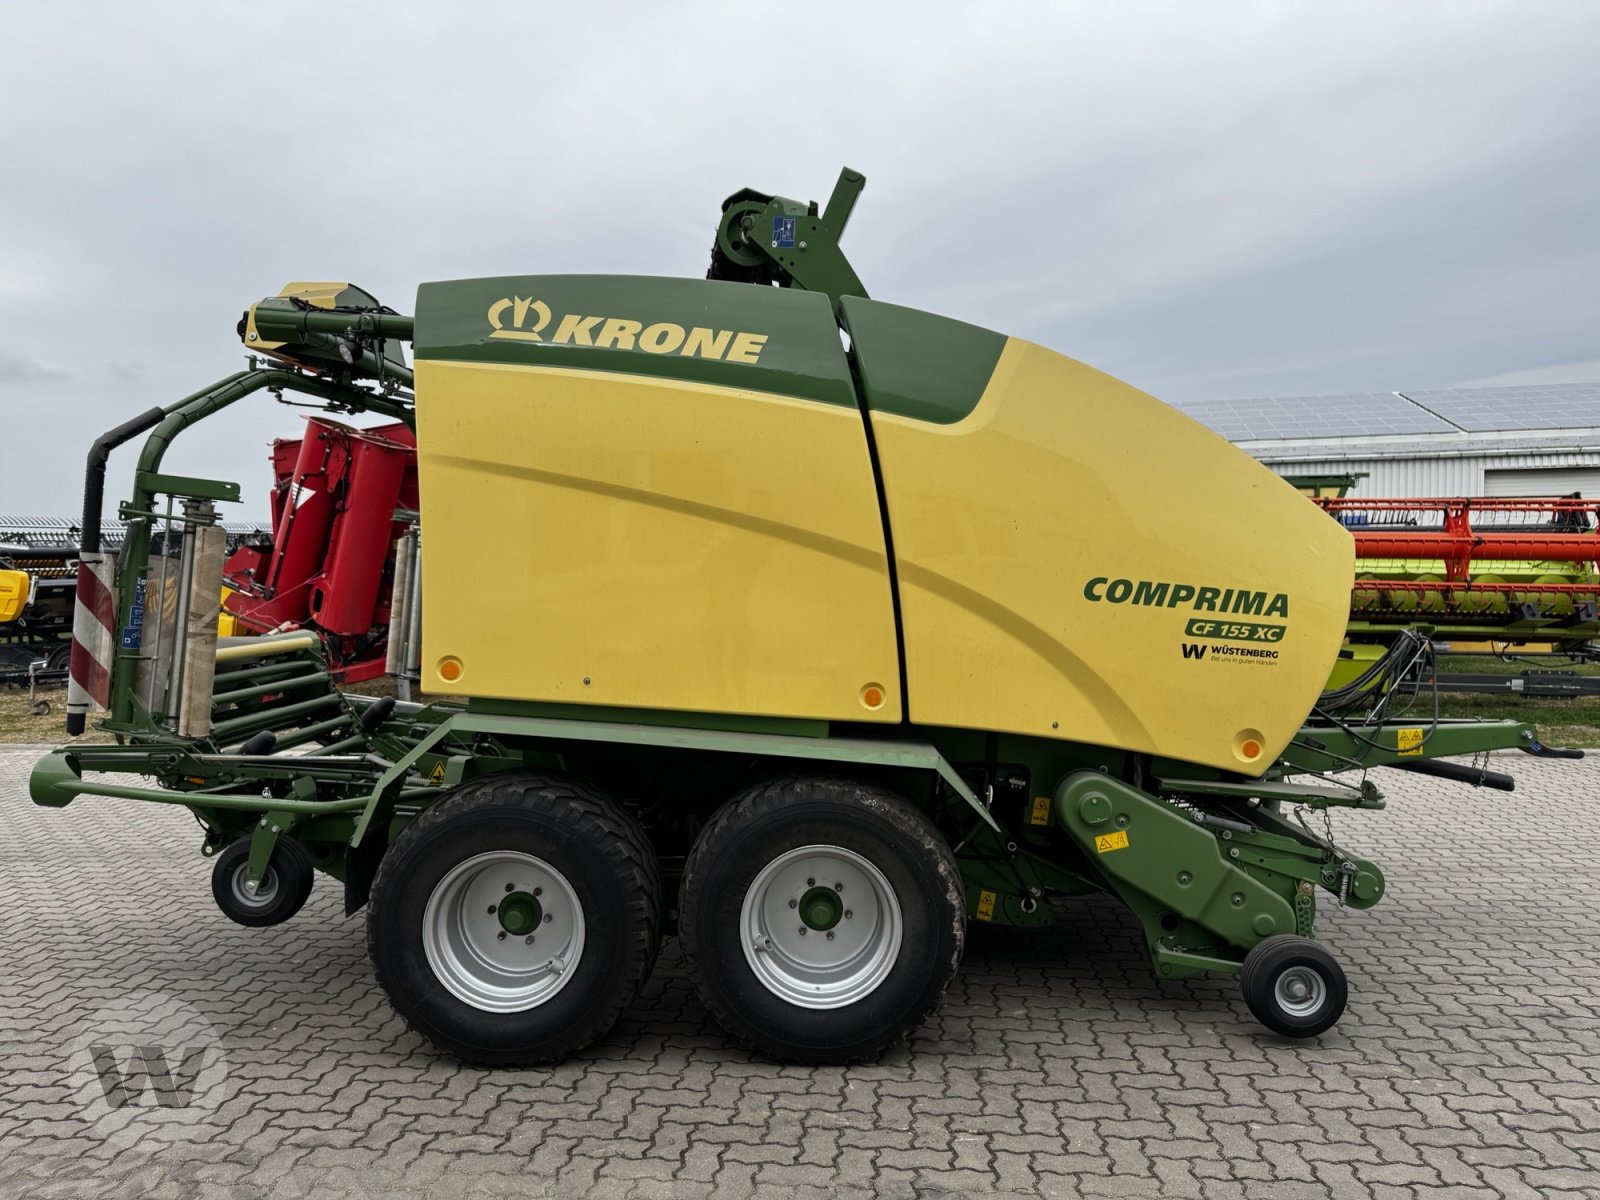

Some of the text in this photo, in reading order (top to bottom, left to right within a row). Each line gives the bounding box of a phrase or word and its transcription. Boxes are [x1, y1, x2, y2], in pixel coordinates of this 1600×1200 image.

[551, 314, 769, 364] KRONE
[1083, 576, 1289, 618] COMPRIMA
[1191, 622, 1280, 641] CF 155 XC
[1211, 645, 1279, 659] WÜSTENBERG
[1238, 657, 1255, 665] guten
